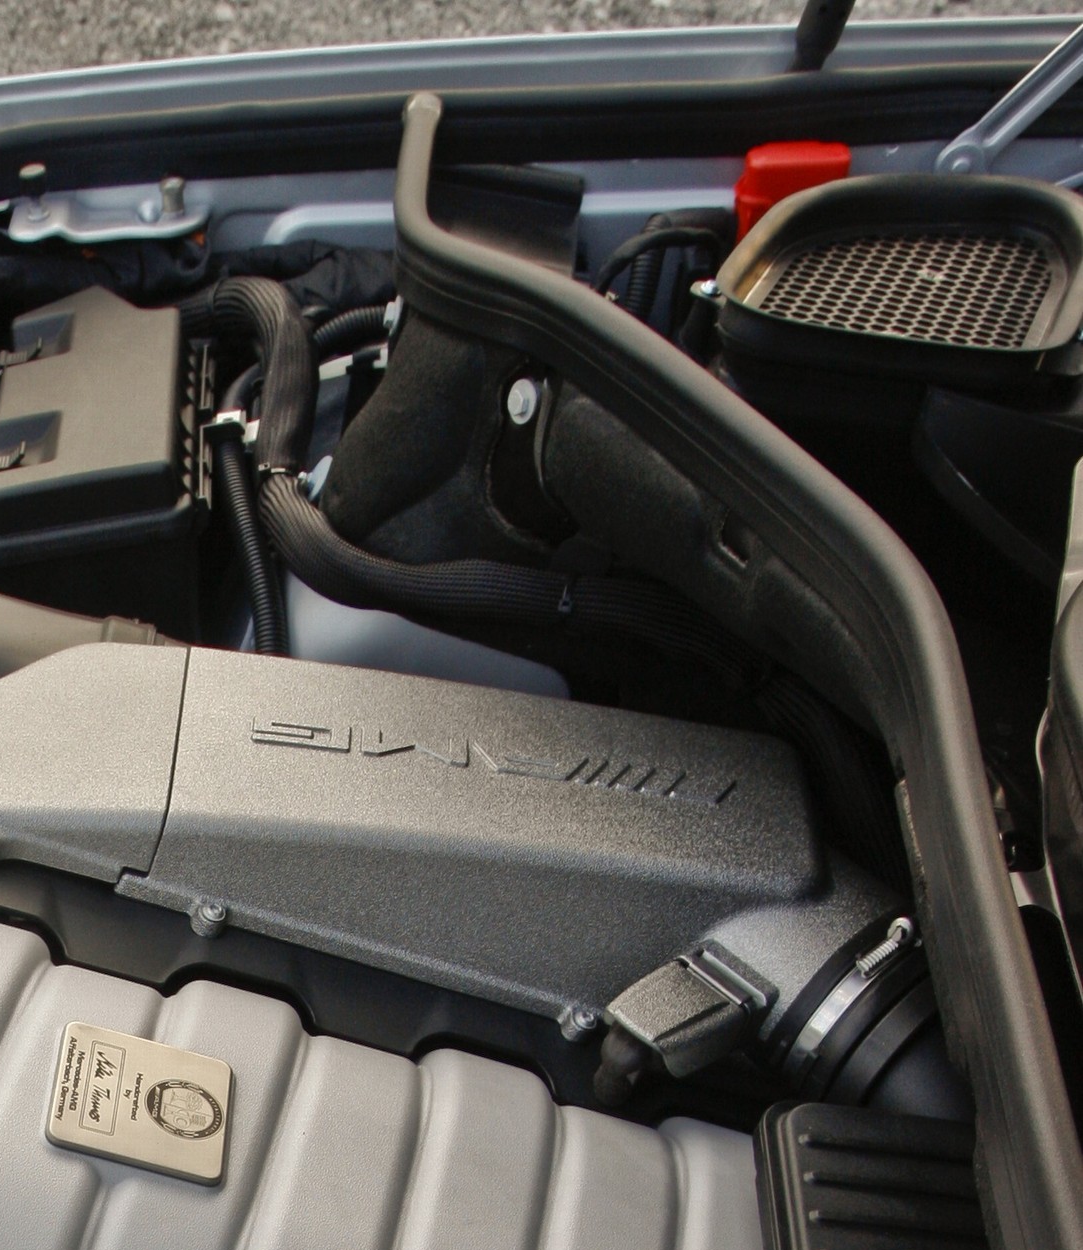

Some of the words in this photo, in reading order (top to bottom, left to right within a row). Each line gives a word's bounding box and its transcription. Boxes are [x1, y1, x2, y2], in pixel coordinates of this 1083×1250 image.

[61, 1036, 78, 1085] Affalterbach,
[68, 1050, 86, 1112] Mercedes-AMG
[55, 1085, 70, 1121] Germany
[123, 1089, 133, 1099] by
[130, 1072, 144, 1121] Handcrafted
